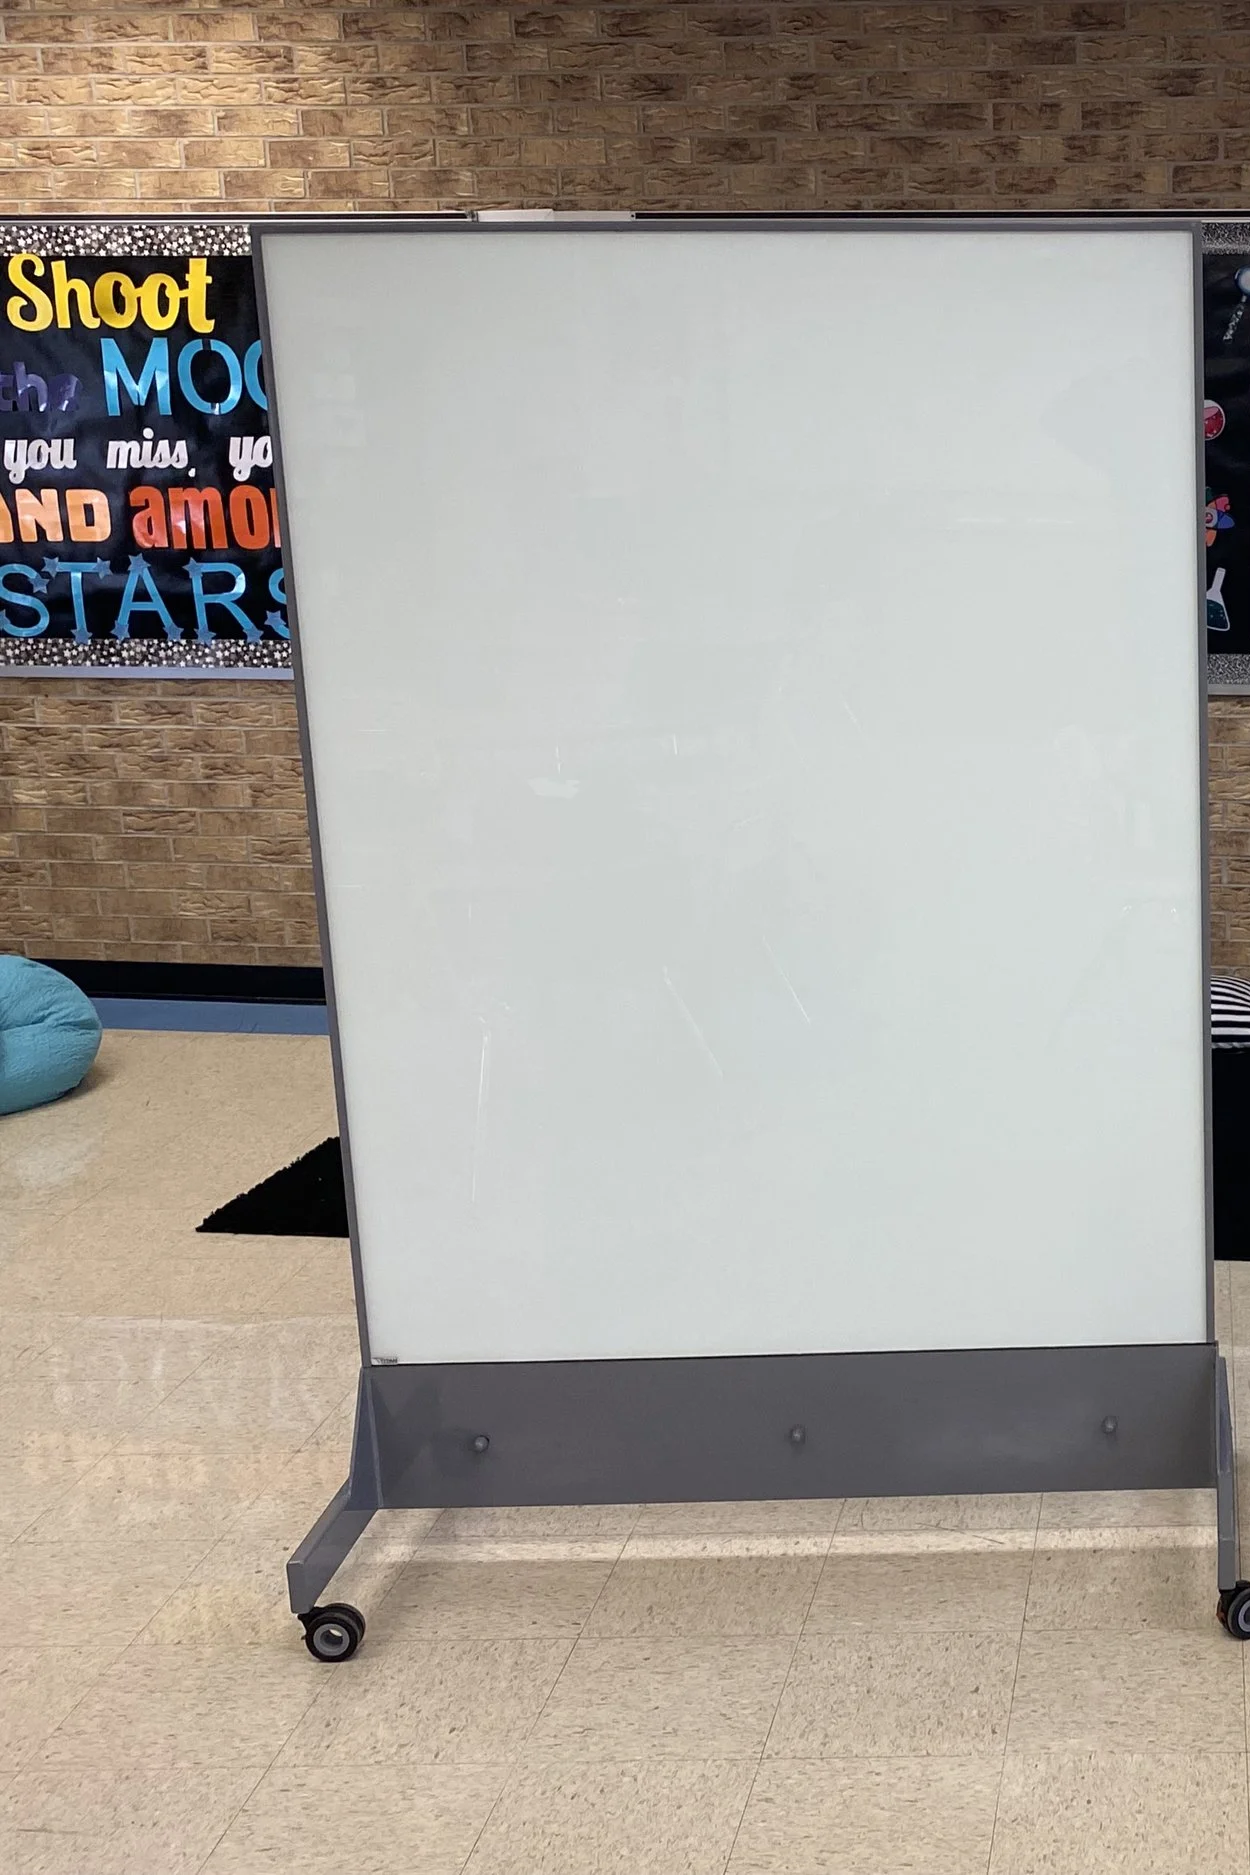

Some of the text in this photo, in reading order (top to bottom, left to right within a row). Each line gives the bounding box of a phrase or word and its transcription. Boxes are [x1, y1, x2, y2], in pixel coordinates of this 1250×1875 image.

[7, 253, 215, 335] Shoot
[3, 436, 76, 484] you
[106, 428, 195, 477] miss,
[0, 484, 282, 551] ND amo
